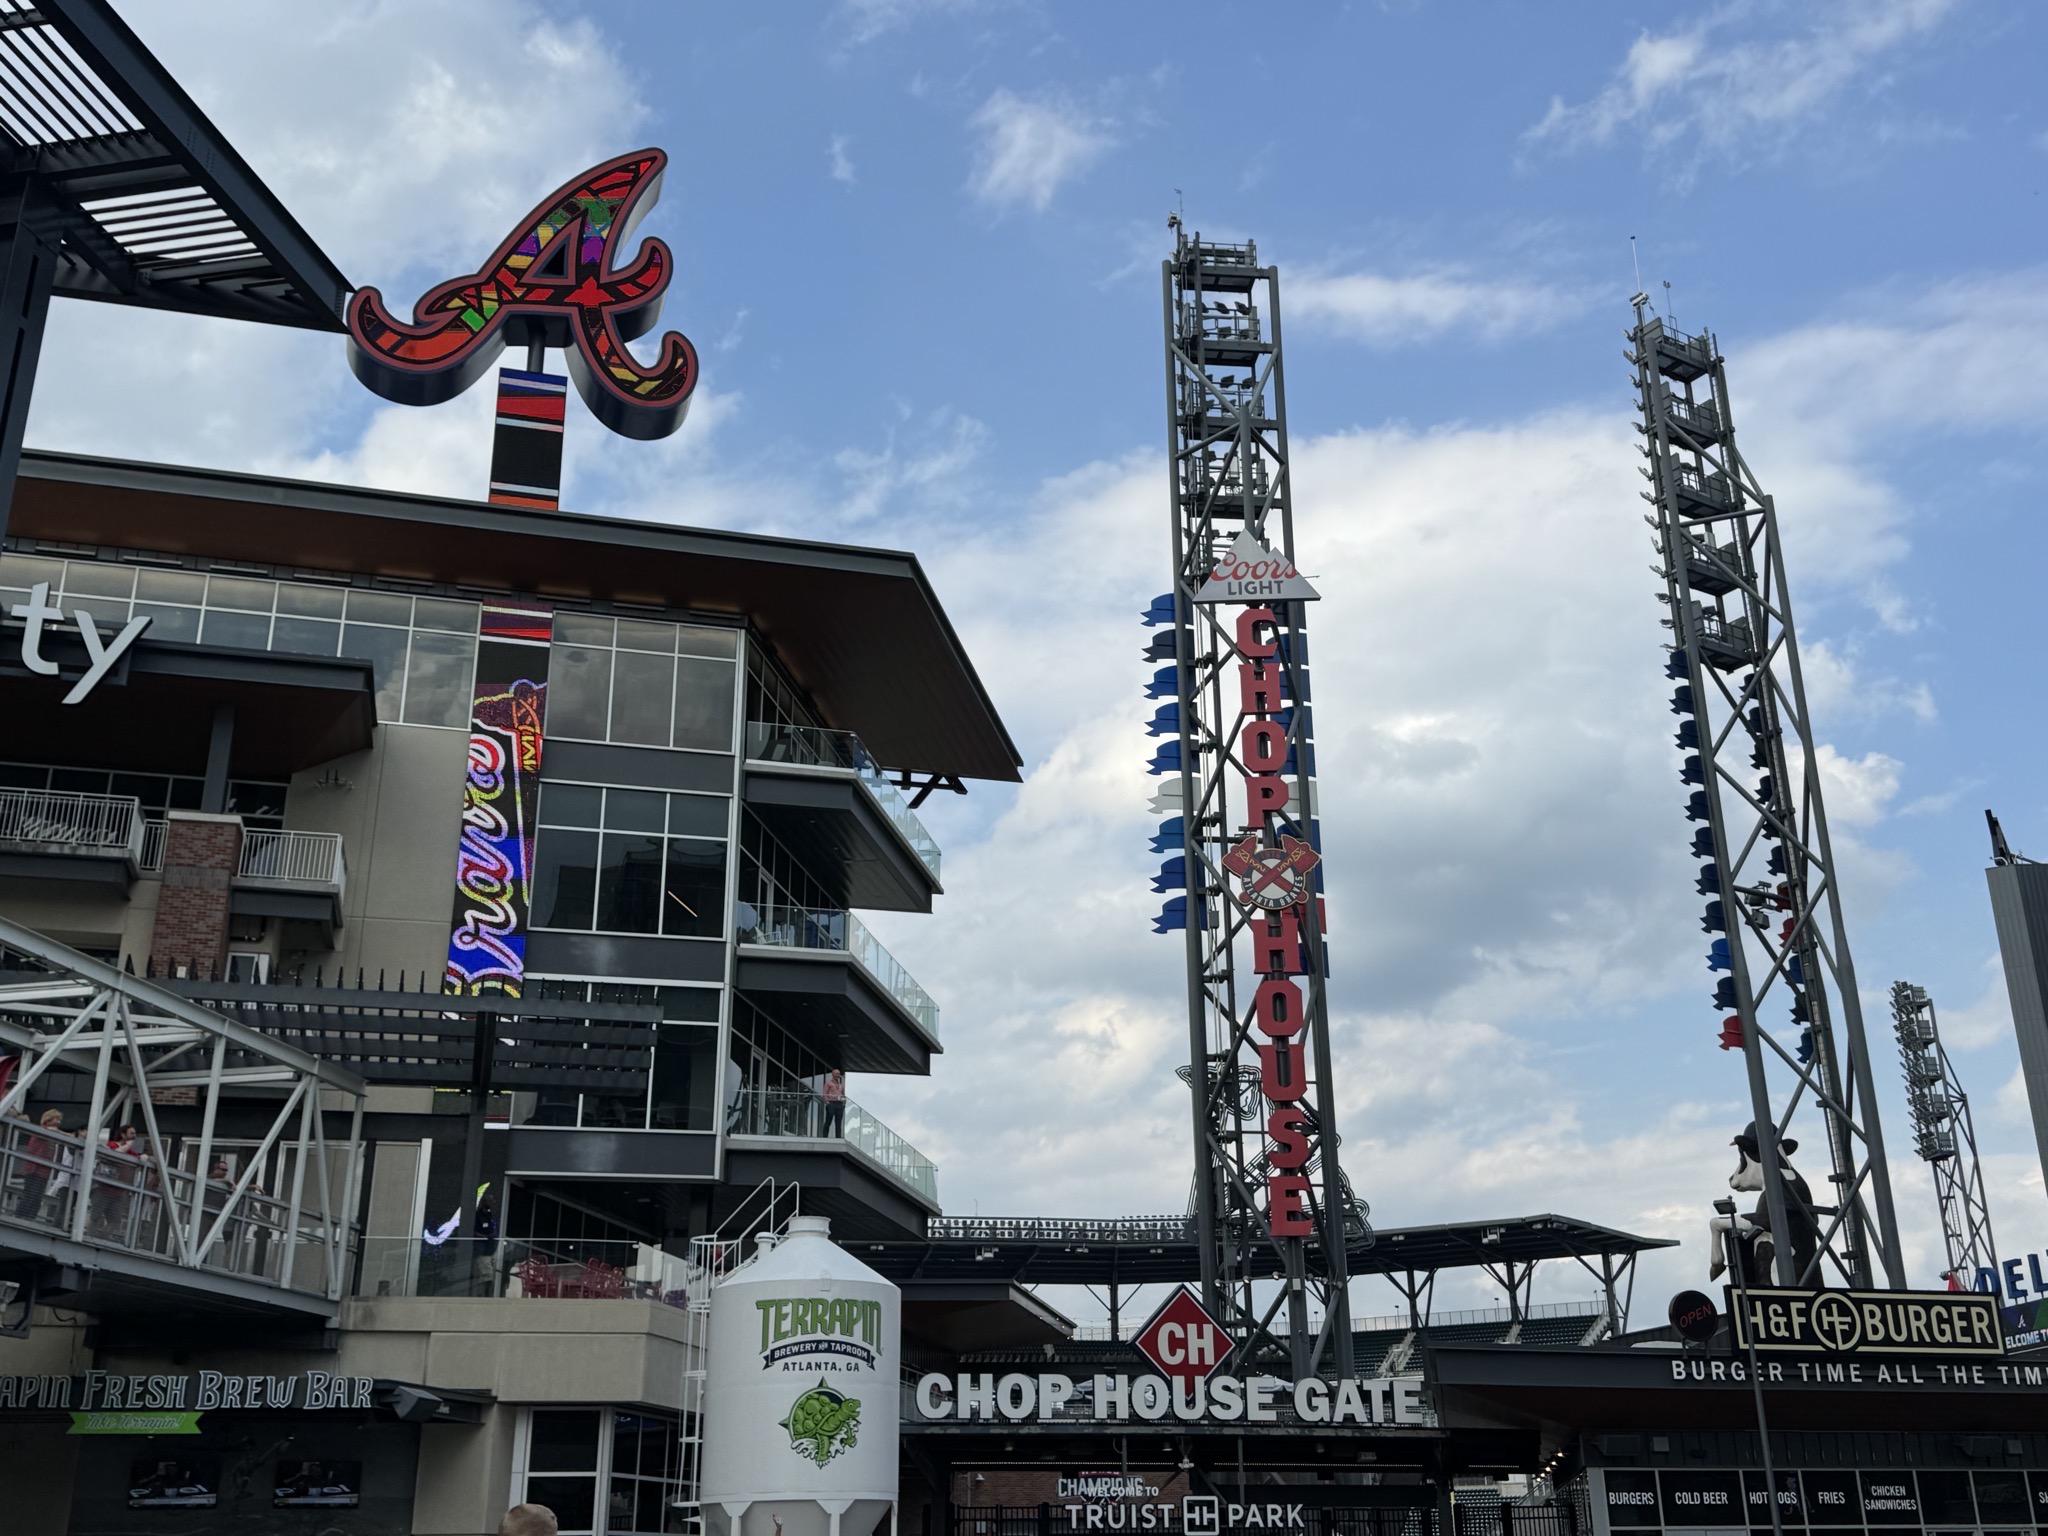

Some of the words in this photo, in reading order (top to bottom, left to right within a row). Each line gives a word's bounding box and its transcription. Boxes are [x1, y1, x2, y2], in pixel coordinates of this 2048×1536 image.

[1211, 552, 1298, 581] Coors
[1227, 581, 1284, 595] LIGHT
[1235, 608, 1289, 829] CHOP
[1243, 877, 1275, 907] ATLANTA
[1279, 876, 1303, 906] BRAVES
[1250, 918, 1314, 1236] HOUSE
[1975, 1249, 2048, 1299] DEL
[755, 1297, 883, 1356] TERRAPIN
[1679, 1303, 1712, 1328] OPEN
[1746, 1300, 1807, 1340] H&F
[1862, 1303, 1994, 1344] BURGER
[774, 1342, 817, 1358] BREWERY
[830, 1342, 868, 1359] TAPROOM
[1157, 1321, 1215, 1365] CH
[2004, 1330, 2041, 1349] ELCOME
[782, 1362, 842, 1372] ATLANTA,
[846, 1362, 860, 1372] GA
[1797, 1363, 1863, 1382] TIME
[1878, 1364, 1924, 1383] ALL
[1936, 1365, 1985, 1384] THE
[1997, 1366, 2048, 1385] TIM
[79, 1369, 190, 1410] FRESH
[194, 1370, 298, 1410] BREW
[302, 1370, 373, 1410] BAR
[916, 1372, 1074, 1420] CHOP
[1093, 1374, 1278, 1421] HOUSE
[1294, 1377, 1423, 1424] GATE
[85, 1412, 116, 1431] Take
[1087, 1486, 1143, 1497] WELCOME
[1144, 1486, 1159, 1497] TO
[1608, 1491, 1655, 1505] BURGERS
[1674, 1491, 1701, 1504] COLD
[1702, 1491, 1729, 1504] BEER
[1749, 1491, 1768, 1504] HOT
[1776, 1491, 1798, 1504] OGS
[1818, 1491, 1846, 1504] FRIES
[1871, 1486, 1906, 1497] CHICKEN
[1064, 1503, 1175, 1529] TRUIST
[1227, 1503, 1305, 1528] PARK
[1865, 1499, 1917, 1511] SANDWICHES
